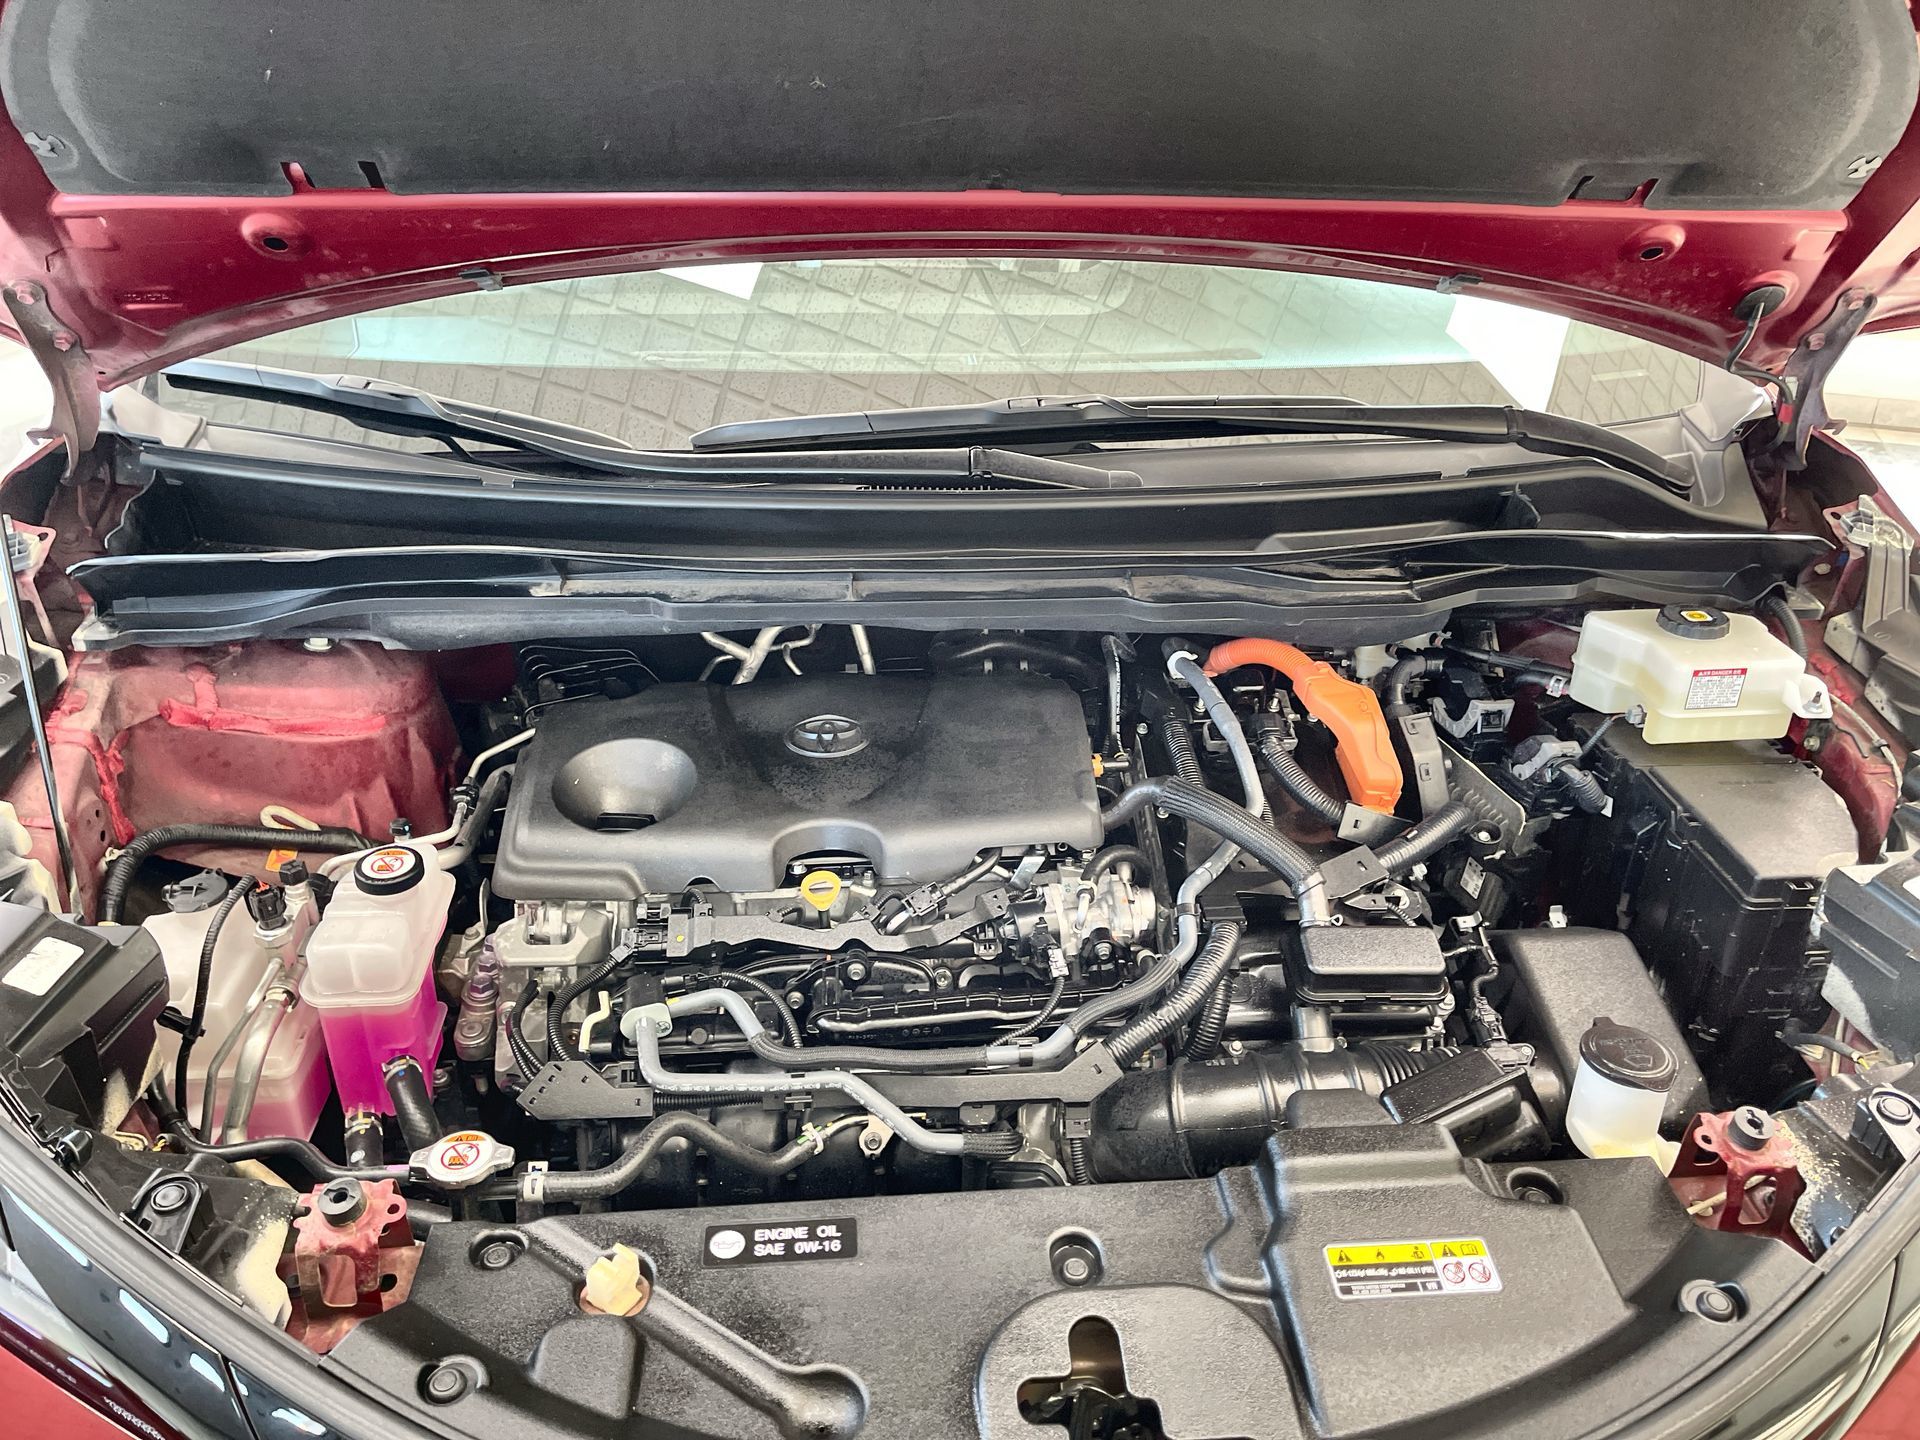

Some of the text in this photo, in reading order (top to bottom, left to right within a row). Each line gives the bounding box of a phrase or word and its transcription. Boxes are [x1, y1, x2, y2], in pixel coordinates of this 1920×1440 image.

[754, 1225, 842, 1241] ENGINE OIL
[753, 1239, 842, 1257] SAE 0W-16
